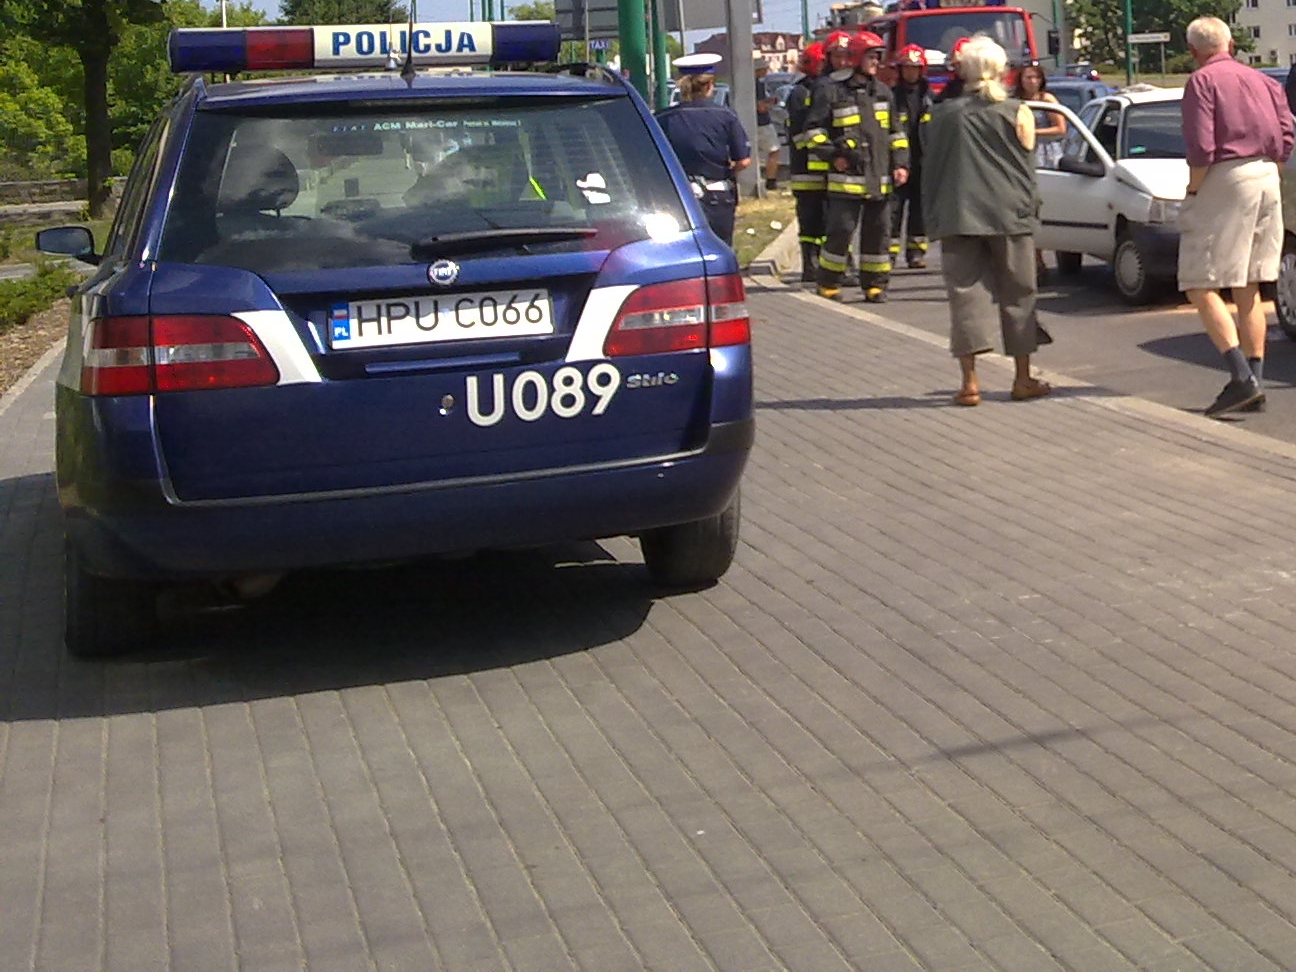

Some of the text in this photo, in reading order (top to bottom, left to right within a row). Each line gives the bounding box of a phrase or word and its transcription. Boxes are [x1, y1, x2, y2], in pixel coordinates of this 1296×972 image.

[332, 29, 477, 55] POLICJA
[591, 39, 609, 49] TAXI
[357, 293, 543, 337] HPU C066
[334, 326, 348, 338] PL
[466, 363, 622, 428] U089
